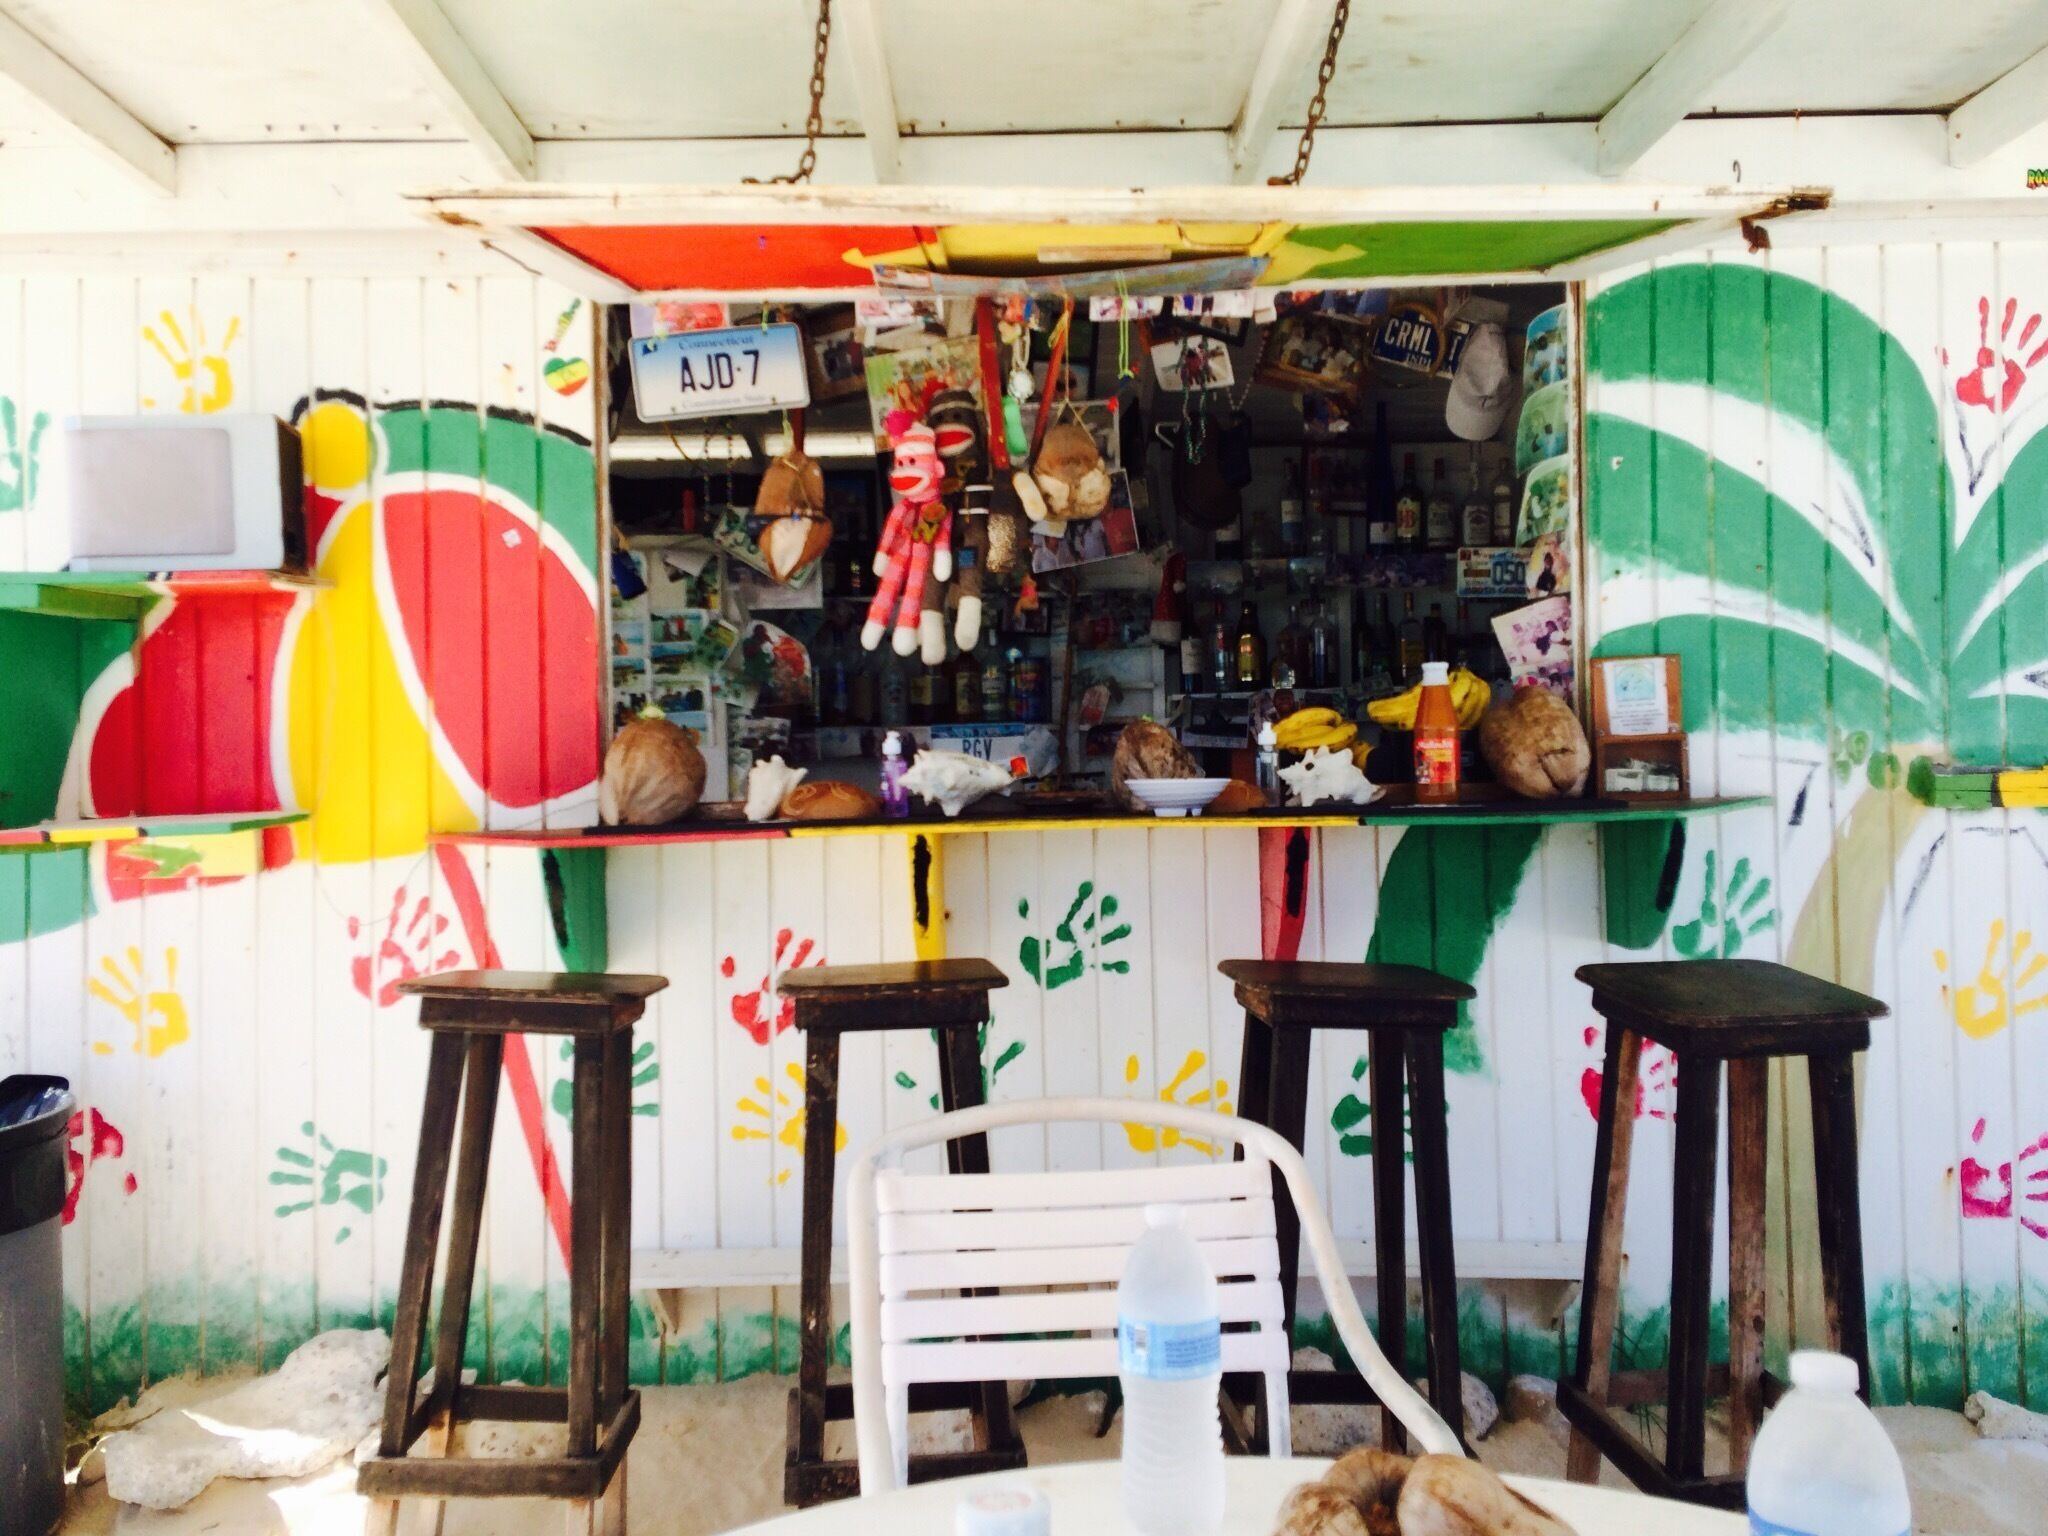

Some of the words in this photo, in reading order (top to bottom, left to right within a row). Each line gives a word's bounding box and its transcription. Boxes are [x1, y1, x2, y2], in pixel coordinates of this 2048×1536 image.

[679, 334, 755, 350] Connecticut
[1384, 318, 1432, 356] CRML
[962, 738, 993, 761] RGV
